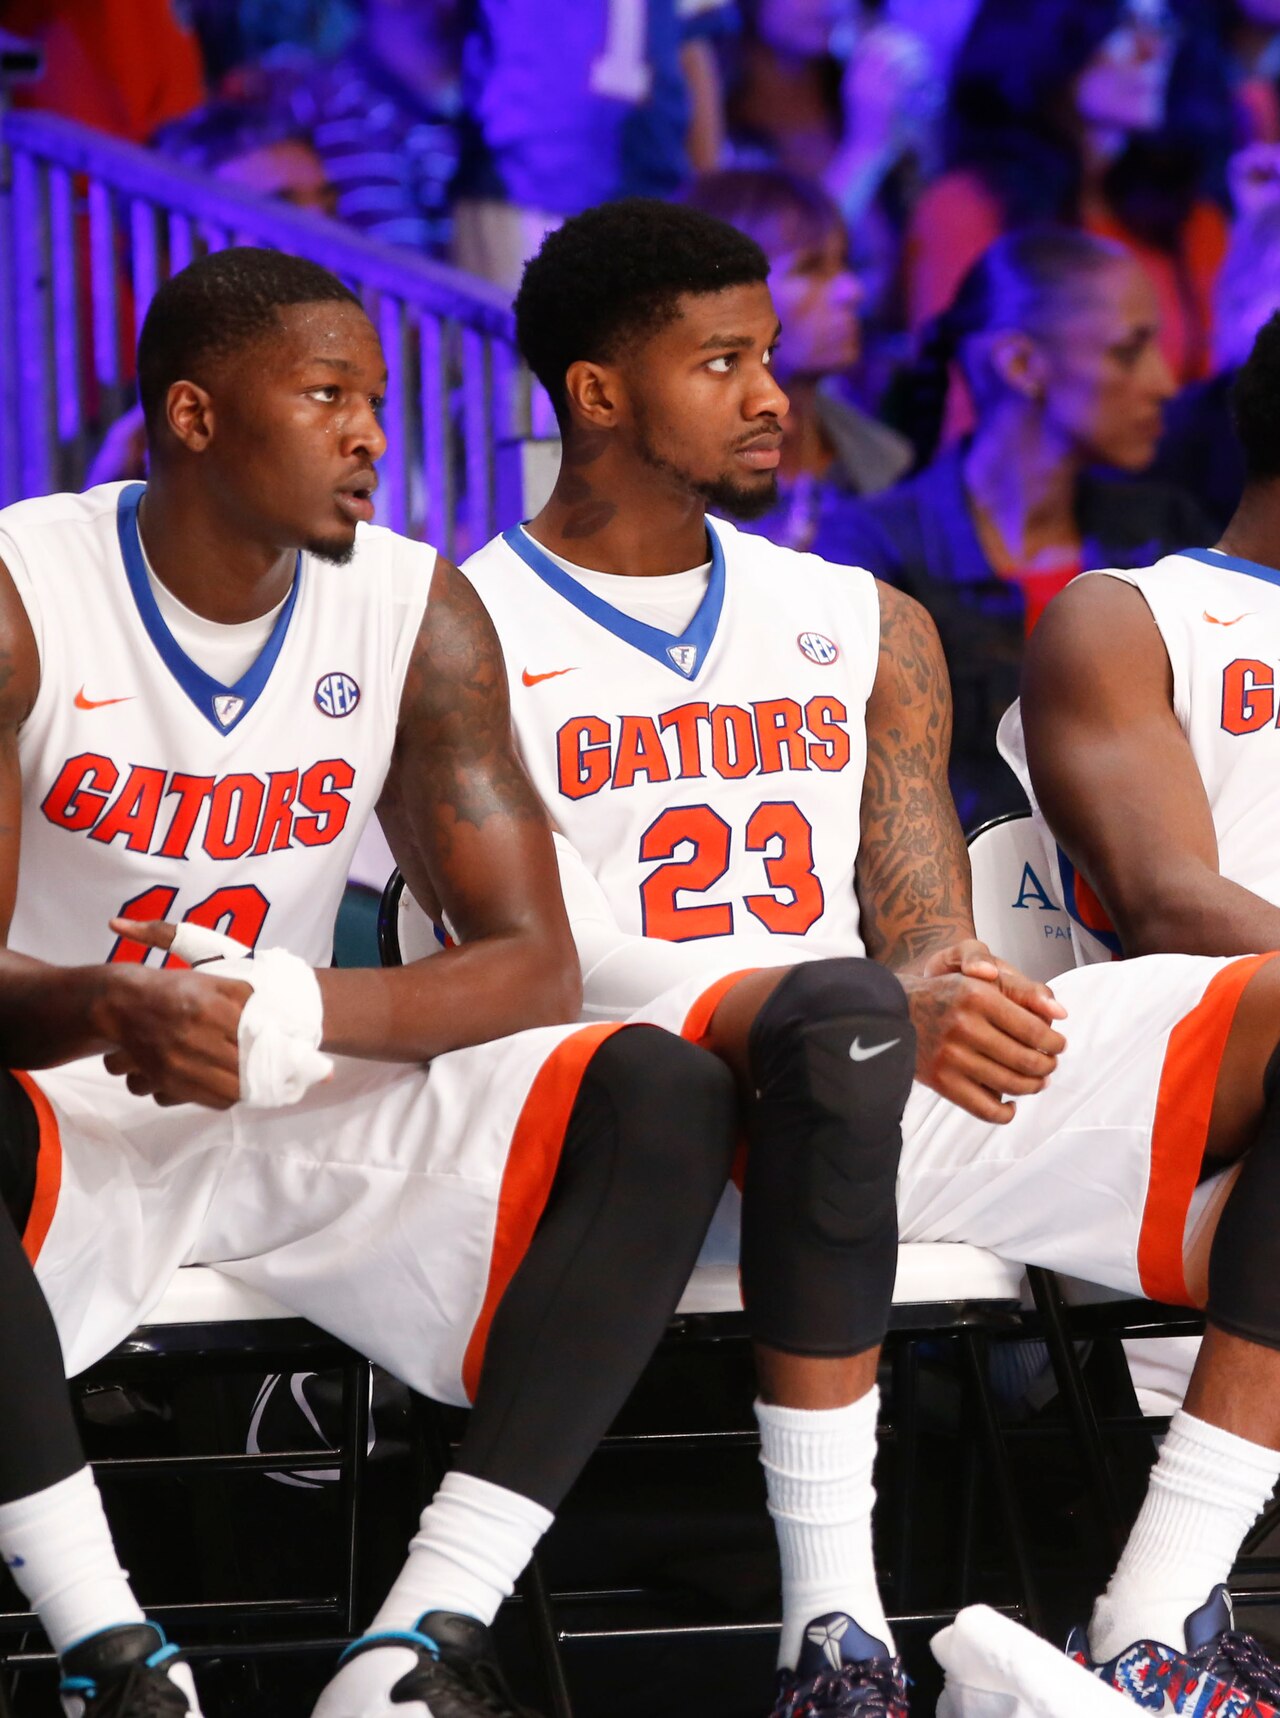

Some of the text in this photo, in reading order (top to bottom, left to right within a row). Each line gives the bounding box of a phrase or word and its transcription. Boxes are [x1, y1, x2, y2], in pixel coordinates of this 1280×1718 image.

[315, 673, 359, 716] SEC
[799, 633, 838, 663] SEC
[556, 695, 850, 800] GATORS
[41, 752, 355, 861] GATORS
[639, 801, 825, 942] 23
